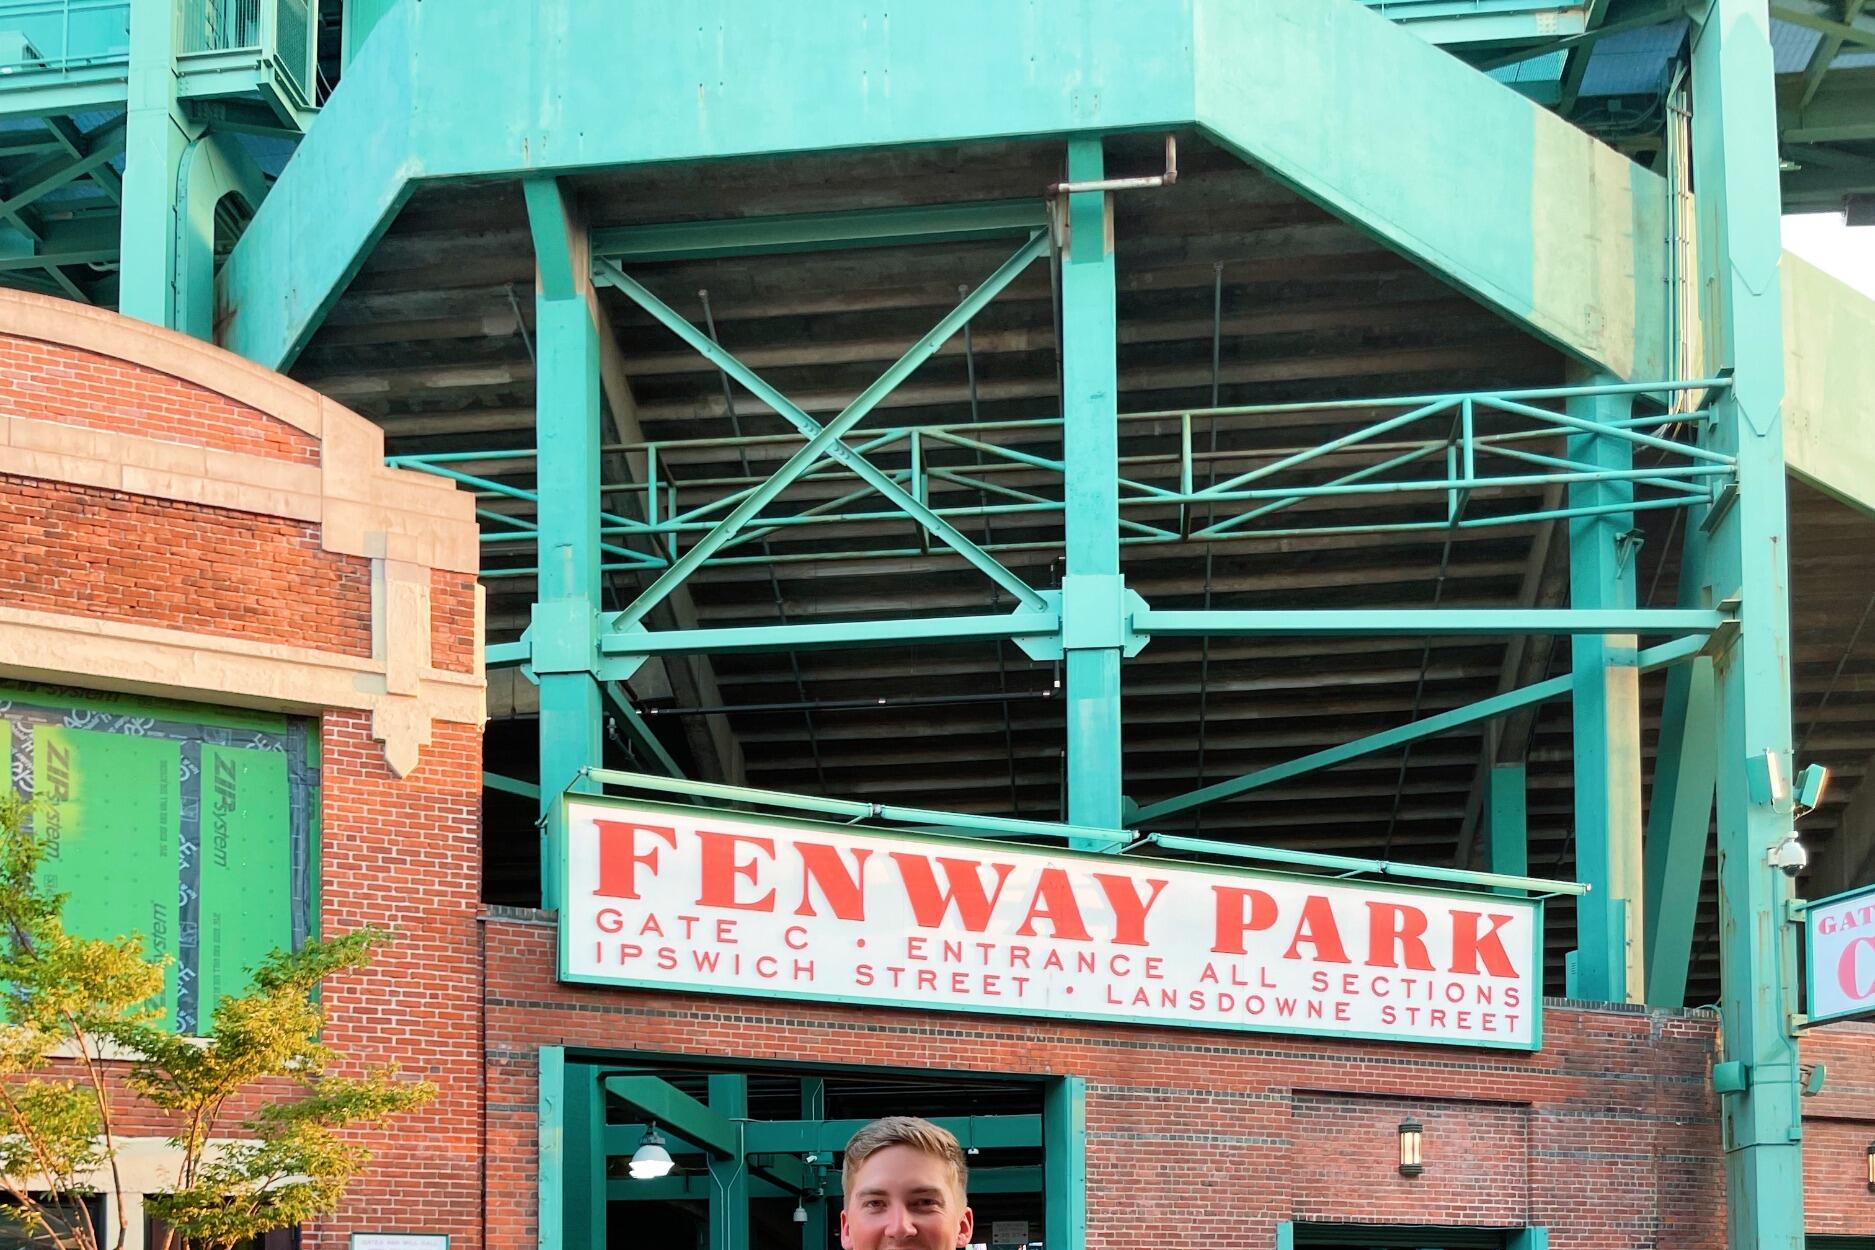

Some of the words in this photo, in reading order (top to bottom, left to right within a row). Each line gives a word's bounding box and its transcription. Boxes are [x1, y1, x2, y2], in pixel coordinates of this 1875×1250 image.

[593, 819, 1169, 946] FENWAY
[1210, 885, 1520, 978] PARK
[596, 908, 739, 944] GATE
[784, 925, 810, 950] C
[907, 936, 1164, 979] ENTRANCE
[1199, 961, 1278, 988] ALL
[1311, 970, 1520, 1008] SECTIONS
[596, 941, 815, 981] IPSWICH
[855, 963, 1030, 997] STREET
[1107, 983, 1352, 1022] LANSDOWNE
[1381, 1004, 1520, 1033] STREET
